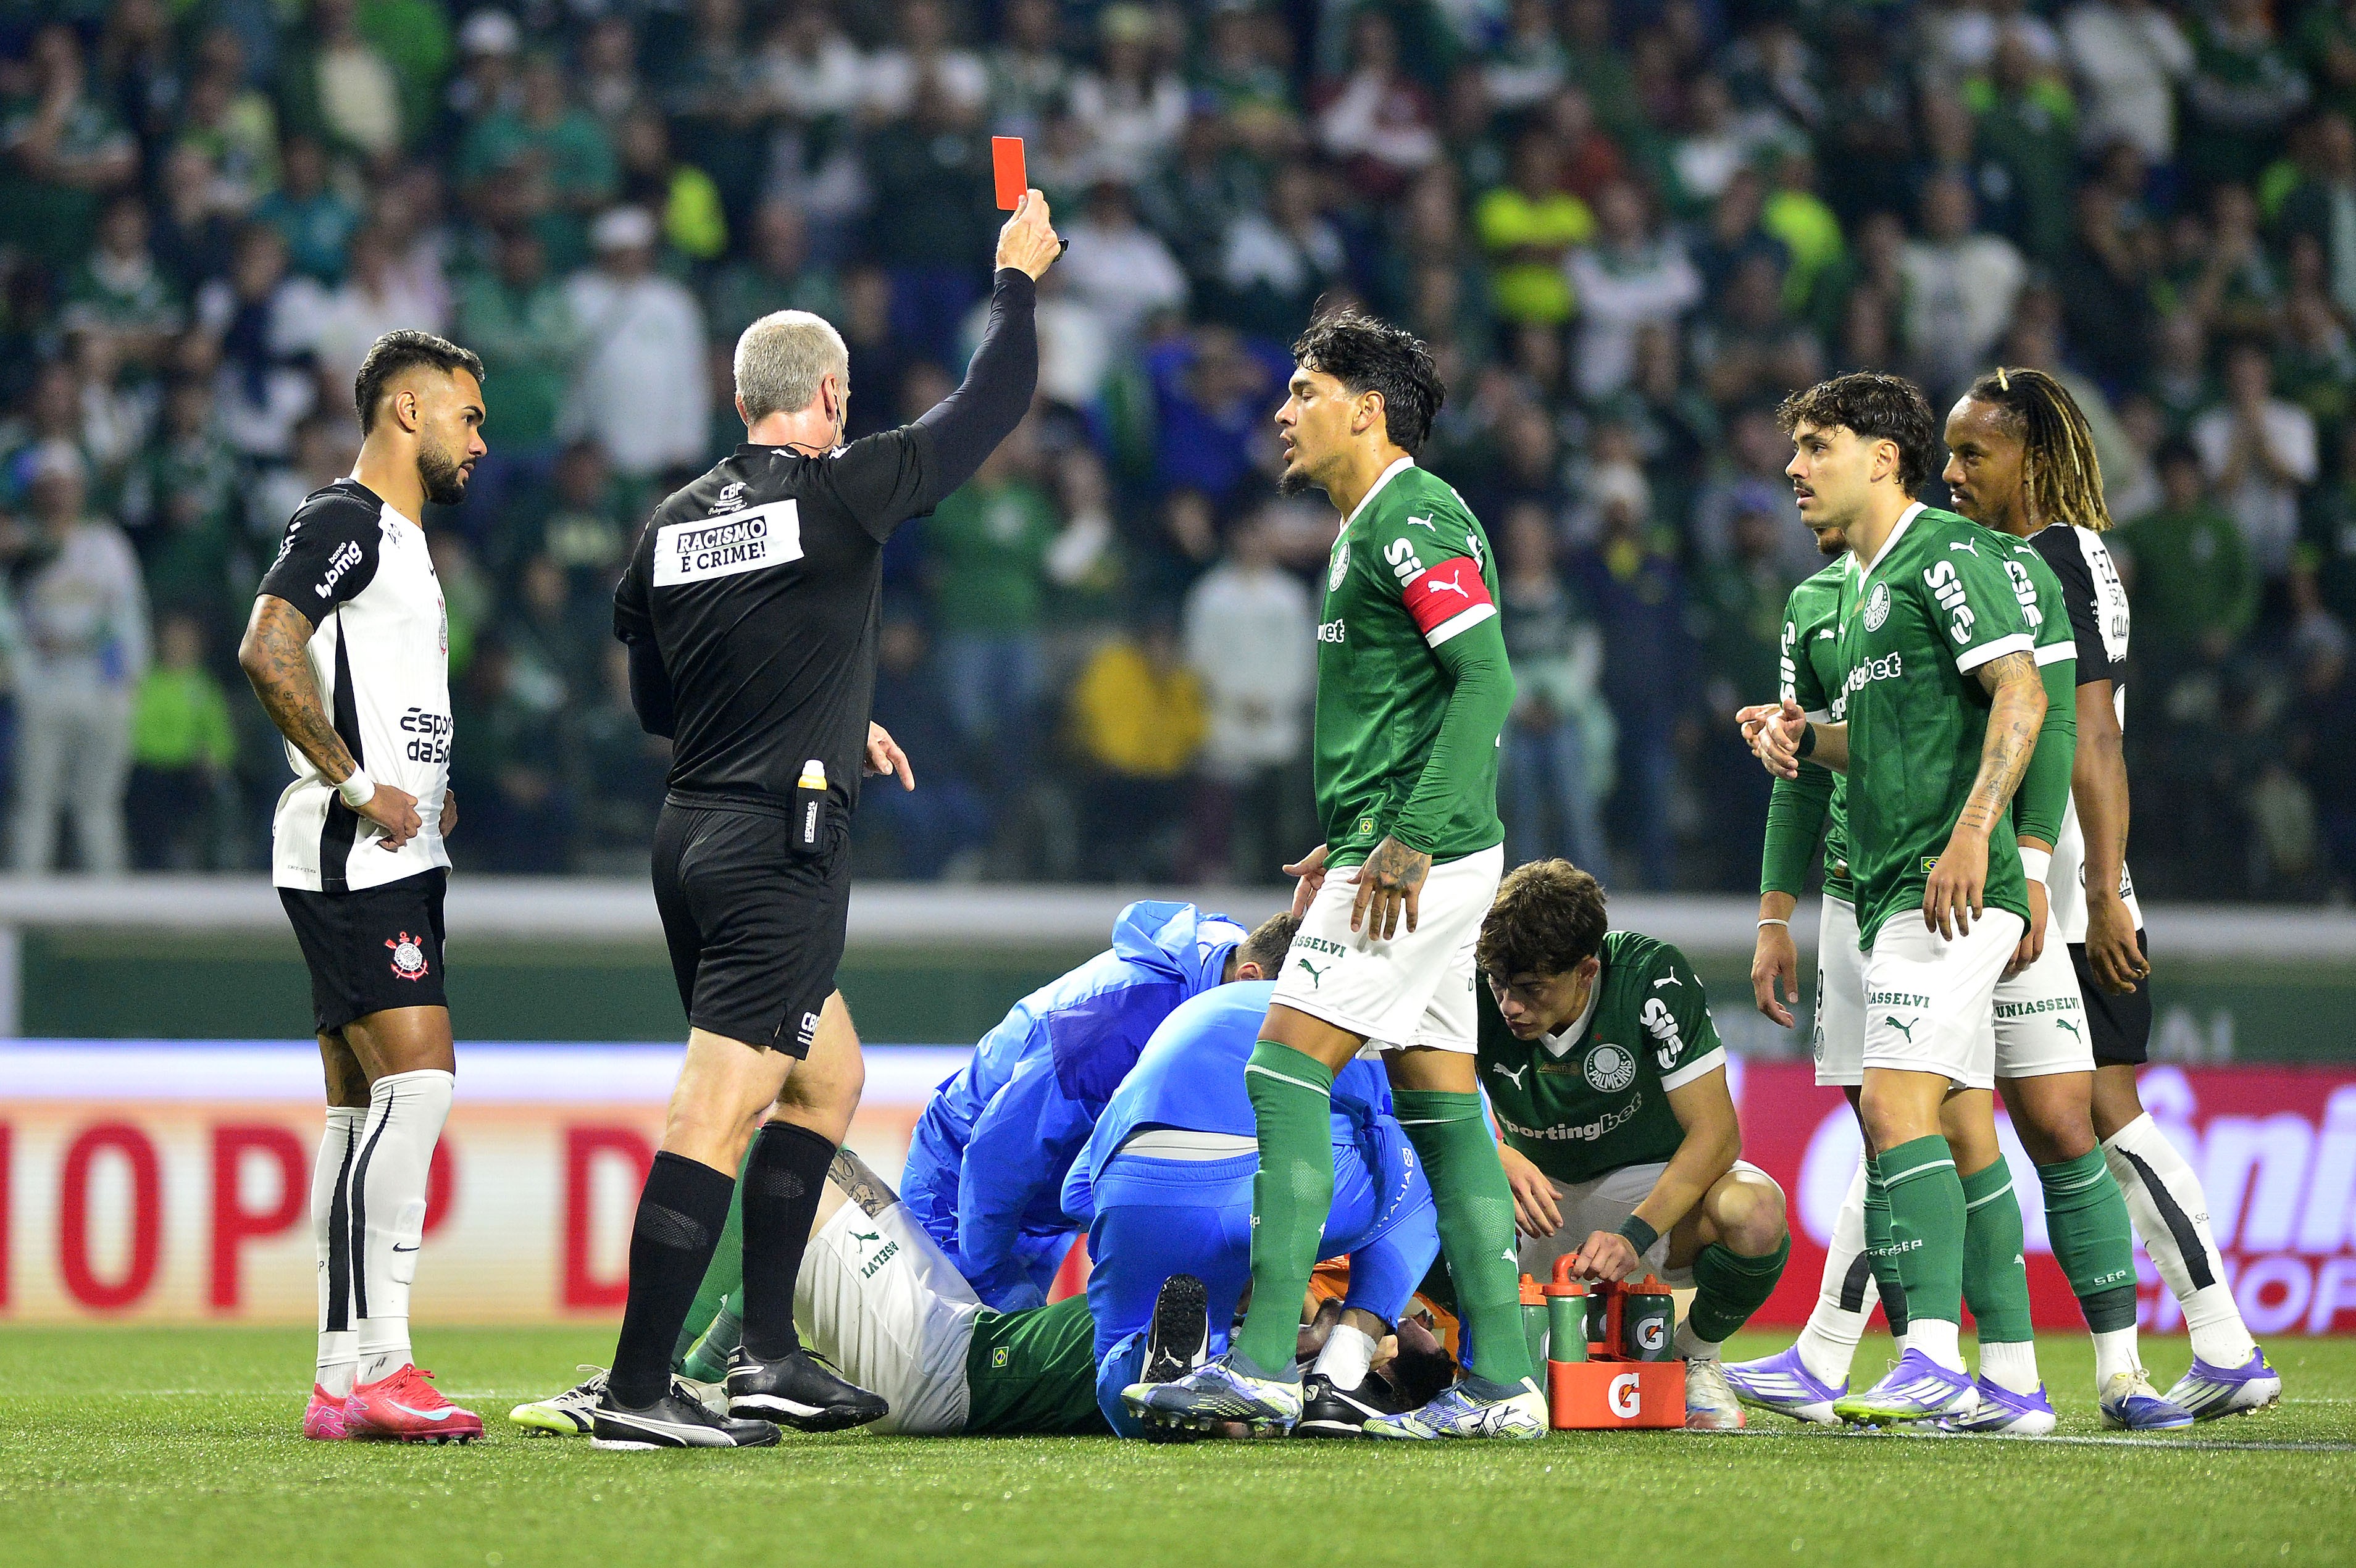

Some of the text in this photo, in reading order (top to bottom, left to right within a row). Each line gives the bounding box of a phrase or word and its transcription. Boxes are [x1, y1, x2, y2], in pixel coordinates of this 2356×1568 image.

[720, 482, 746, 500] CBF
[678, 519, 766, 553] RACISMO
[328, 542, 346, 564] banco
[682, 541, 766, 573] É CRIME!
[1995, 998, 2080, 1018] UNIASSELVI
[1589, 1060, 1632, 1090] PALMEIRAS
[1637, 1317, 1664, 1350] G
[1608, 1373, 1640, 1418] G
